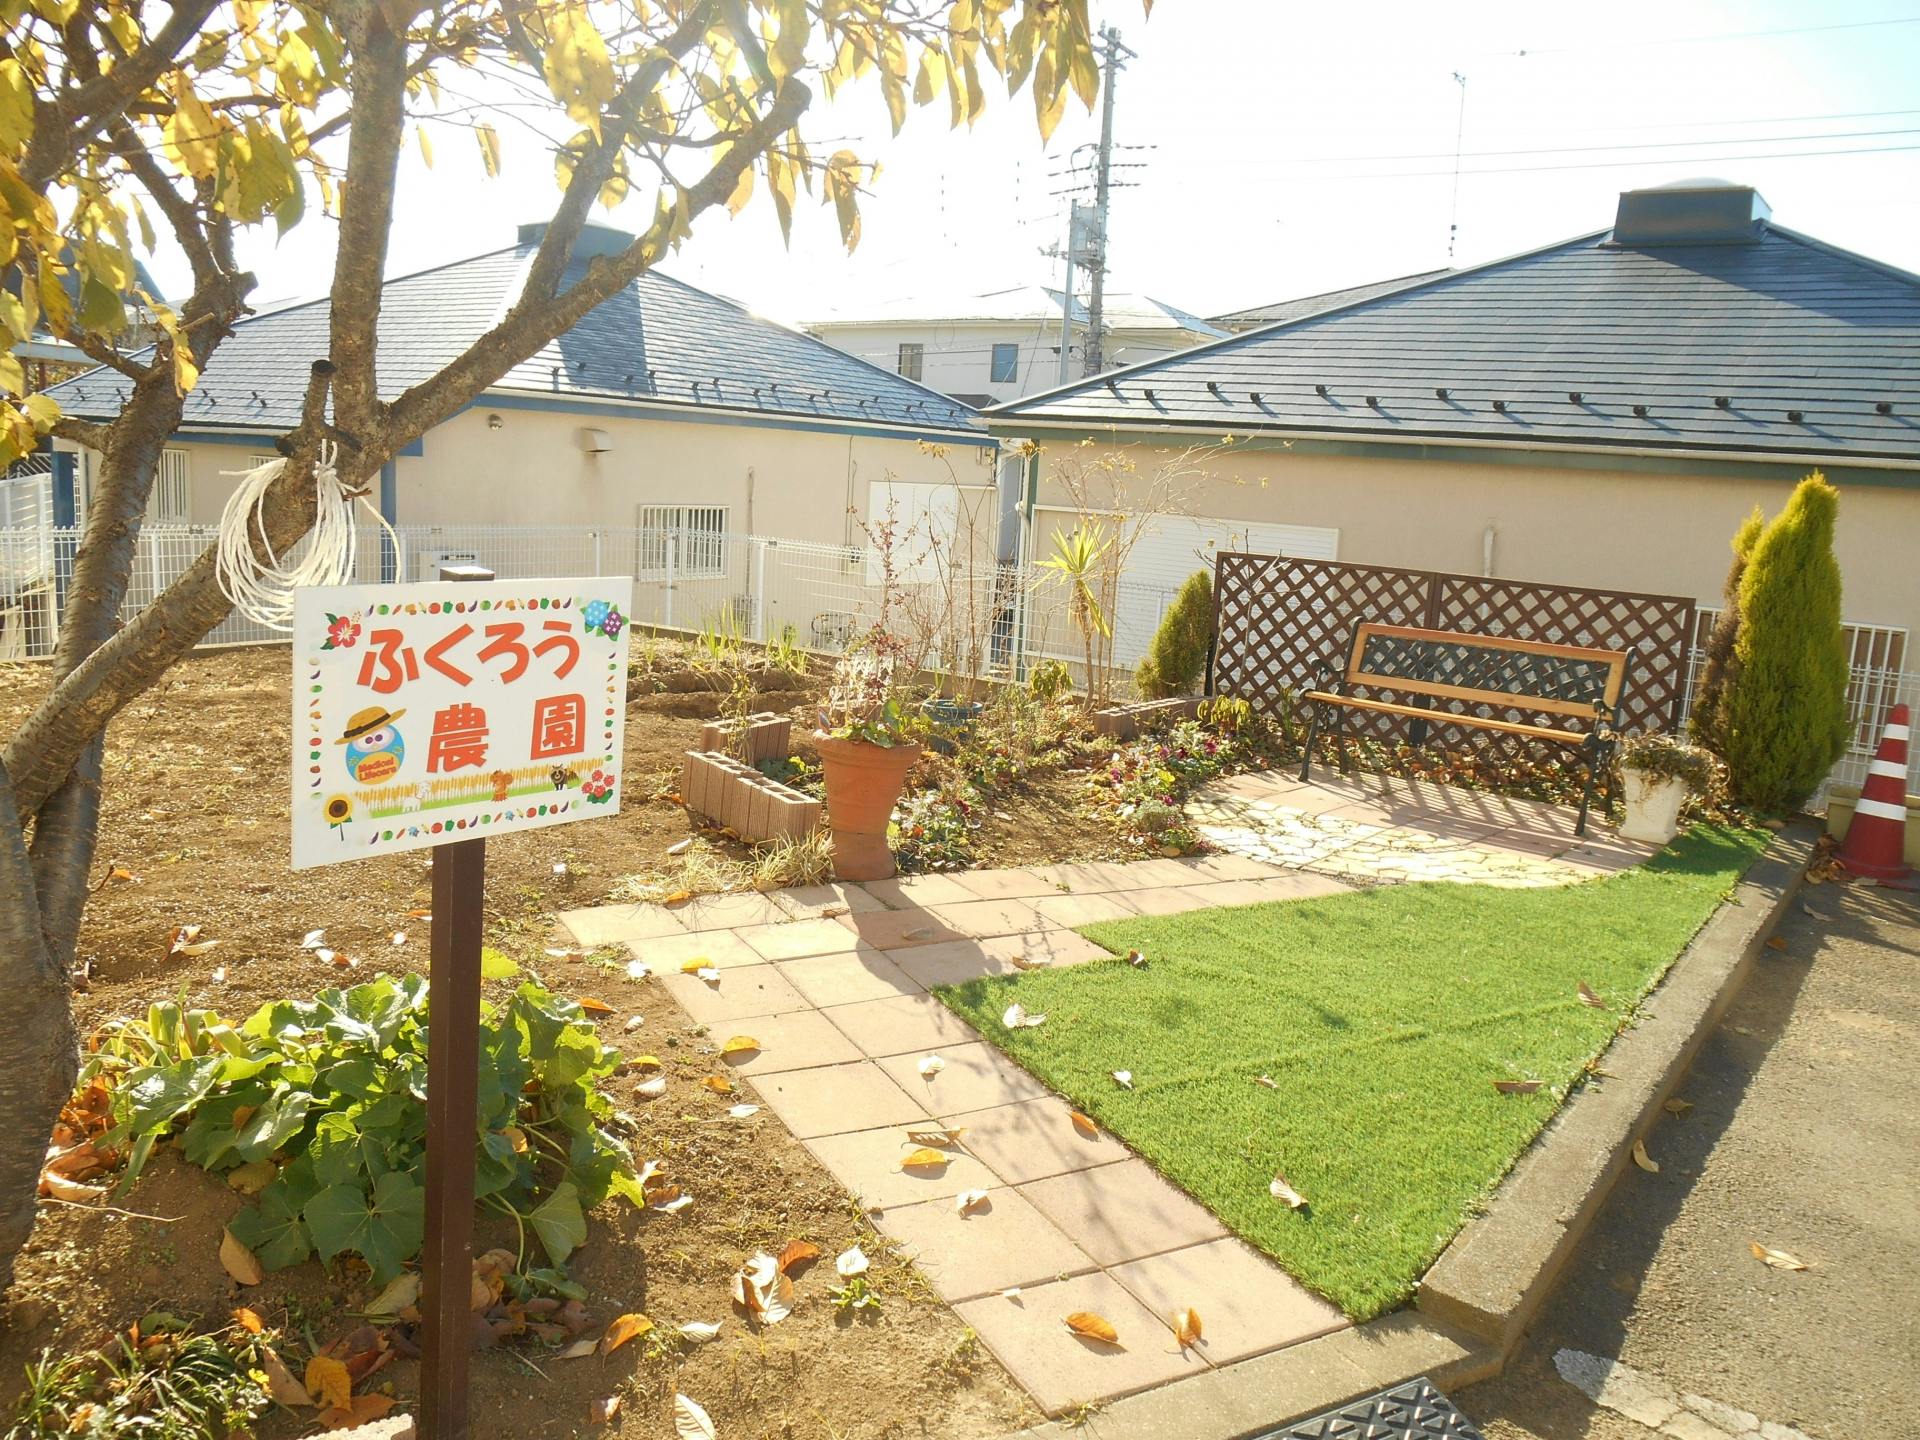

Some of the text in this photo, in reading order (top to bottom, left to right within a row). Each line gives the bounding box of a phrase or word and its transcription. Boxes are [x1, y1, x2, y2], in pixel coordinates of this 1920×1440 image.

[356, 620, 582, 695] ふくろう
[358, 756, 394, 773] Medical
